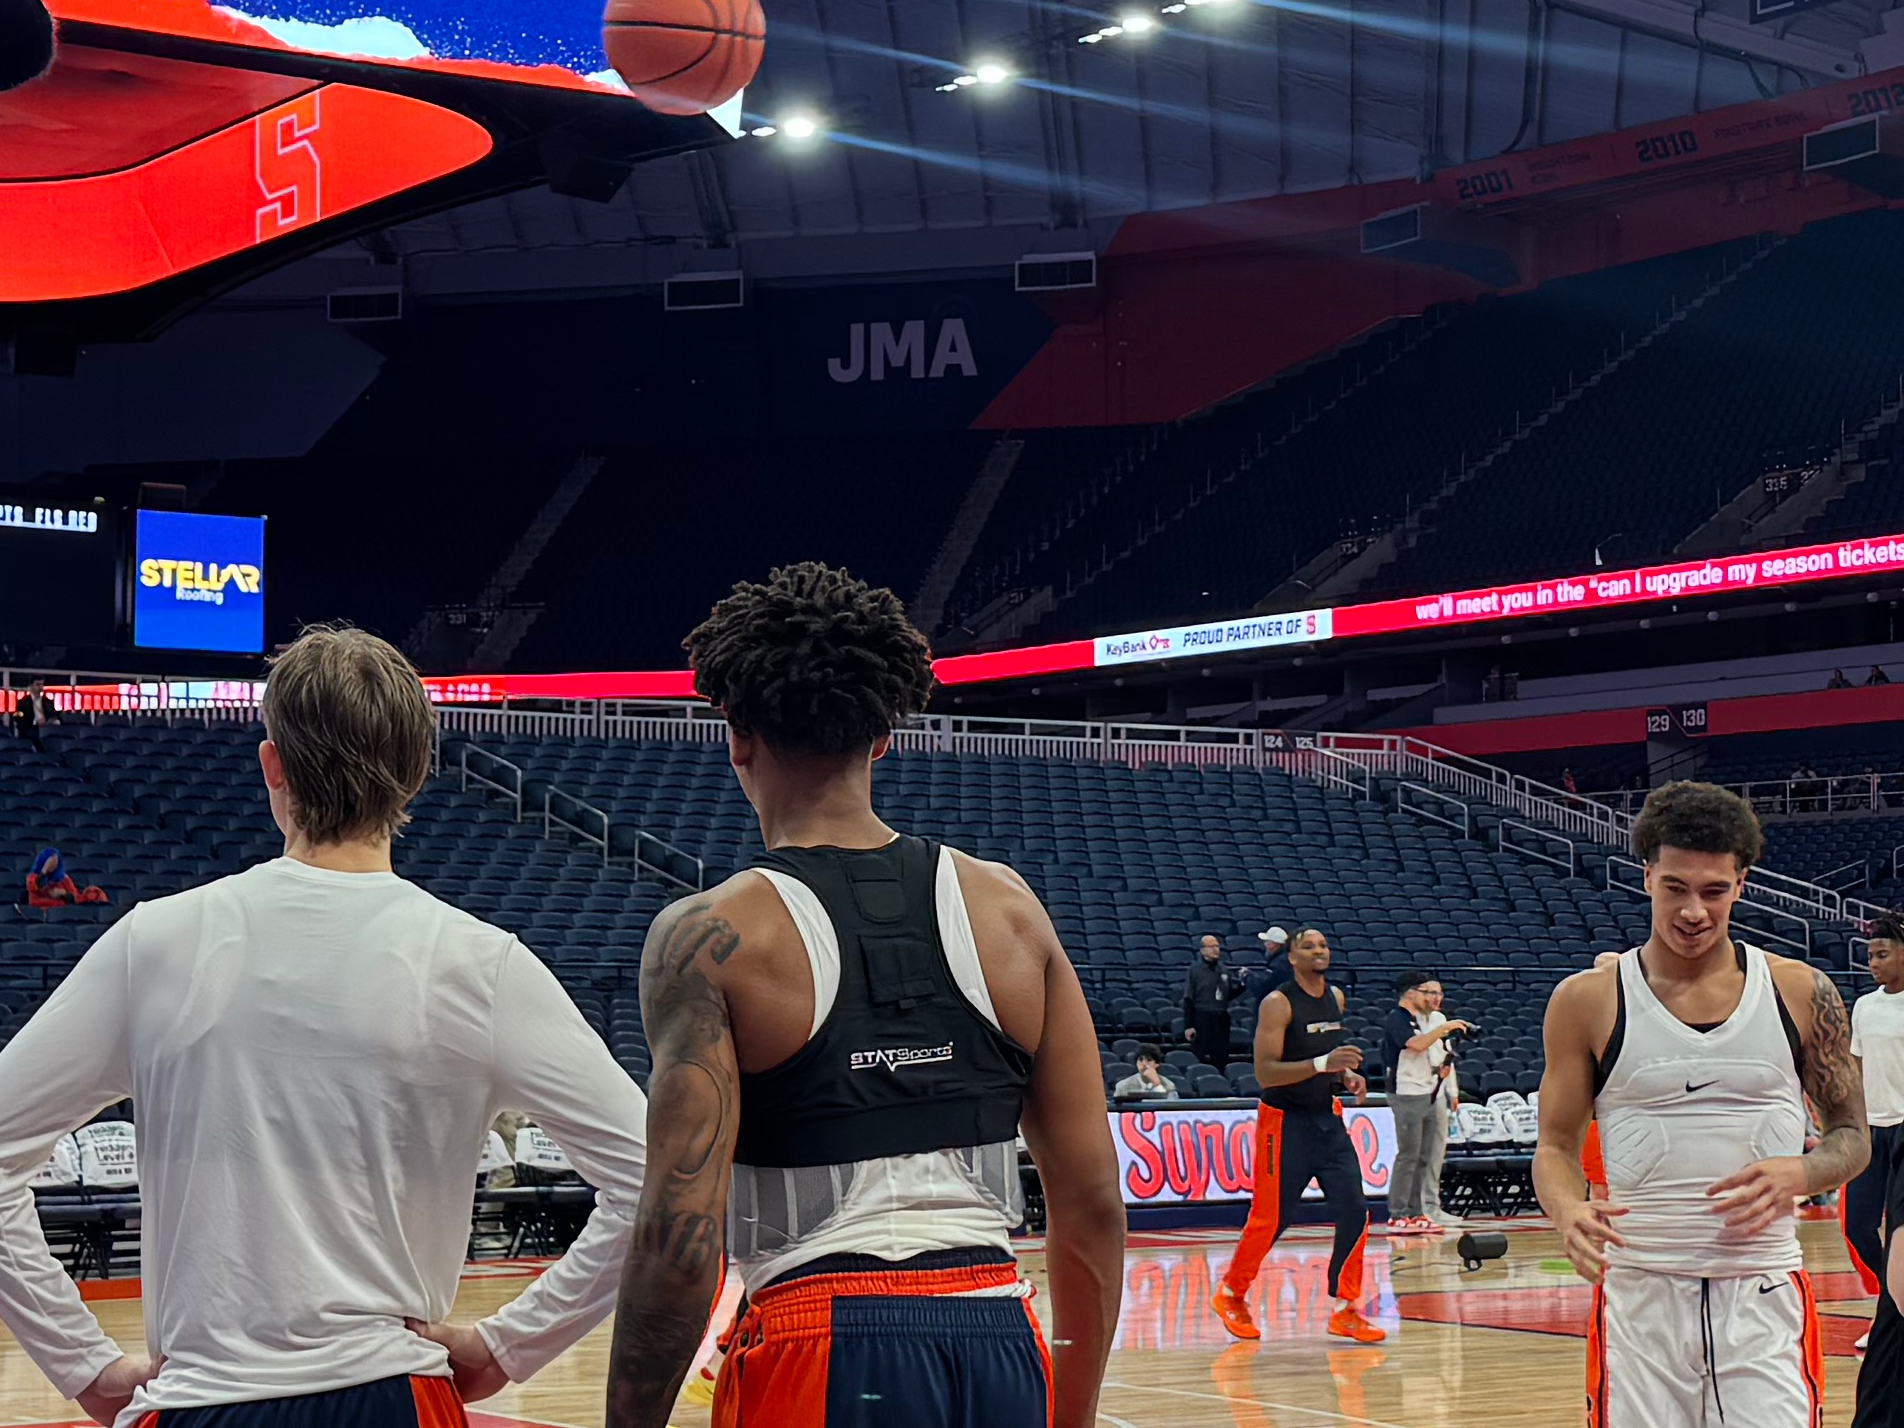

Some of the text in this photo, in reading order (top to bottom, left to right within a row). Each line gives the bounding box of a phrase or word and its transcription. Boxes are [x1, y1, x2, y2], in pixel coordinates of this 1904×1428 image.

[1635, 129, 1699, 163] 2010
[1456, 169, 1514, 200] 2001
[827, 317, 979, 383] JMA
[140, 558, 261, 593] STELLAR
[1416, 596, 1452, 620] we'll
[1456, 592, 1499, 615] meet
[1501, 591, 1532, 614] you
[1537, 582, 1552, 603] in
[1556, 581, 1584, 602] the
[1588, 575, 1631, 597] "can
[1635, 574, 1641, 592] I
[1645, 563, 1722, 595] upgrade
[1728, 562, 1756, 584] my
[1761, 552, 1833, 578] season
[1106, 639, 1147, 657] KeyBank
[1183, 627, 1223, 647] PROUD
[1227, 621, 1282, 642] PARTNER
[1286, 619, 1301, 635] OF
[1647, 709, 1705, 732] 129 130
[1264, 736, 1283, 749] 124
